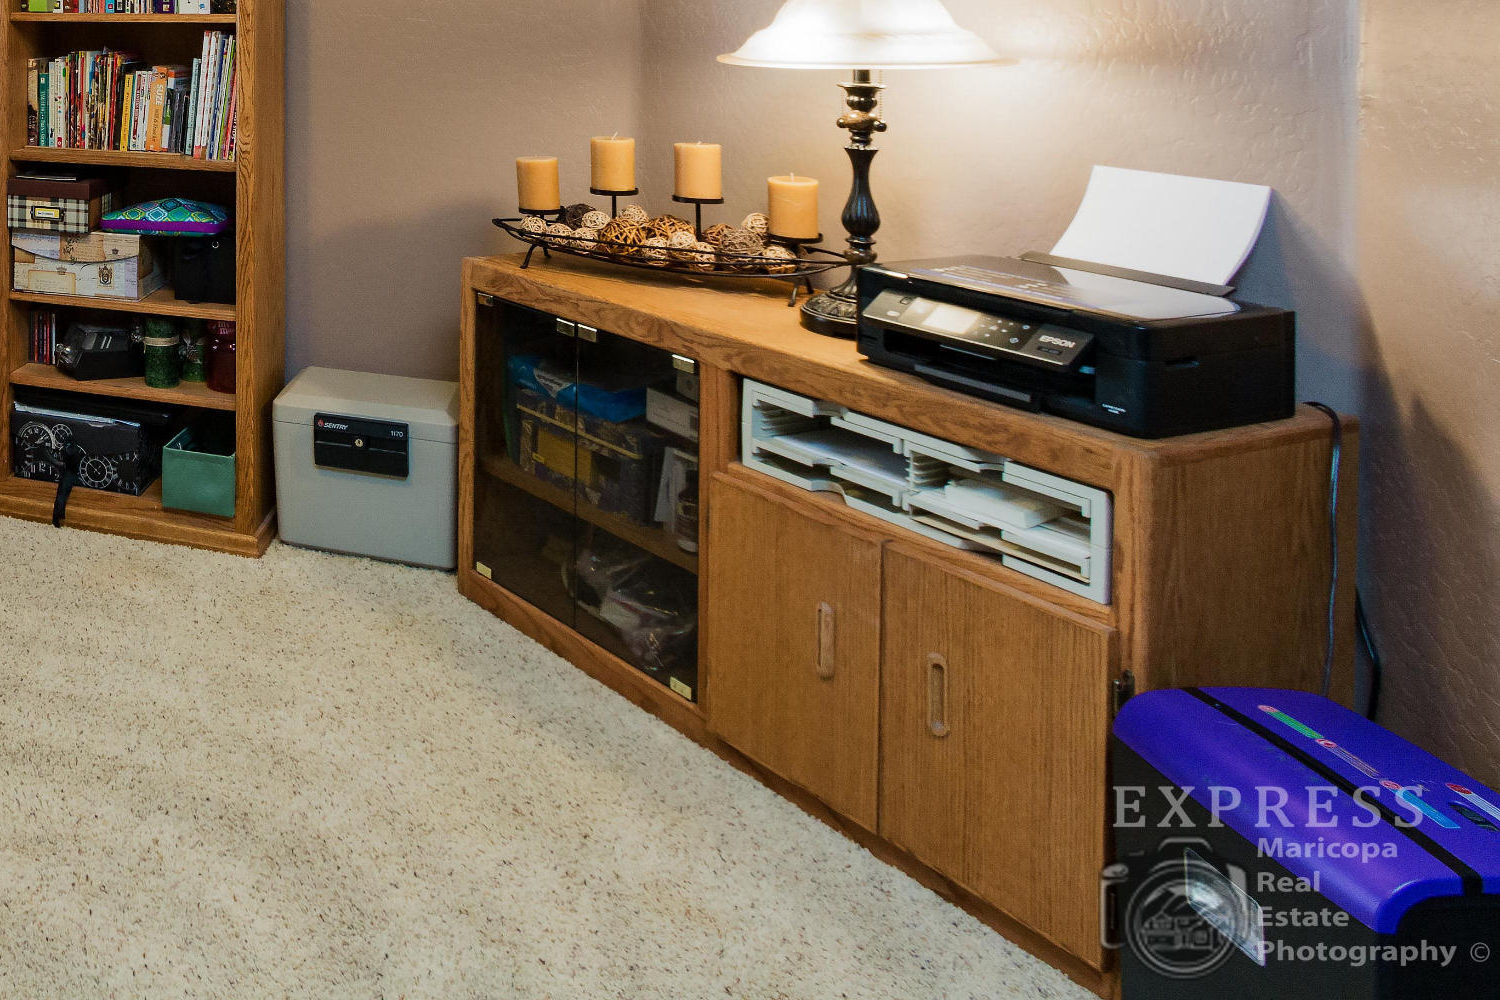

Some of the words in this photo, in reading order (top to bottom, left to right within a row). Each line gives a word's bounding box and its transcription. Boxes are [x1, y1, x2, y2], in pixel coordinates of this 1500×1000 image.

[155, 83, 164, 106] SUZE
[1039, 335, 1076, 348] EPSON
[323, 422, 349, 430] SENTRY
[390, 430, 404, 438] 1170
